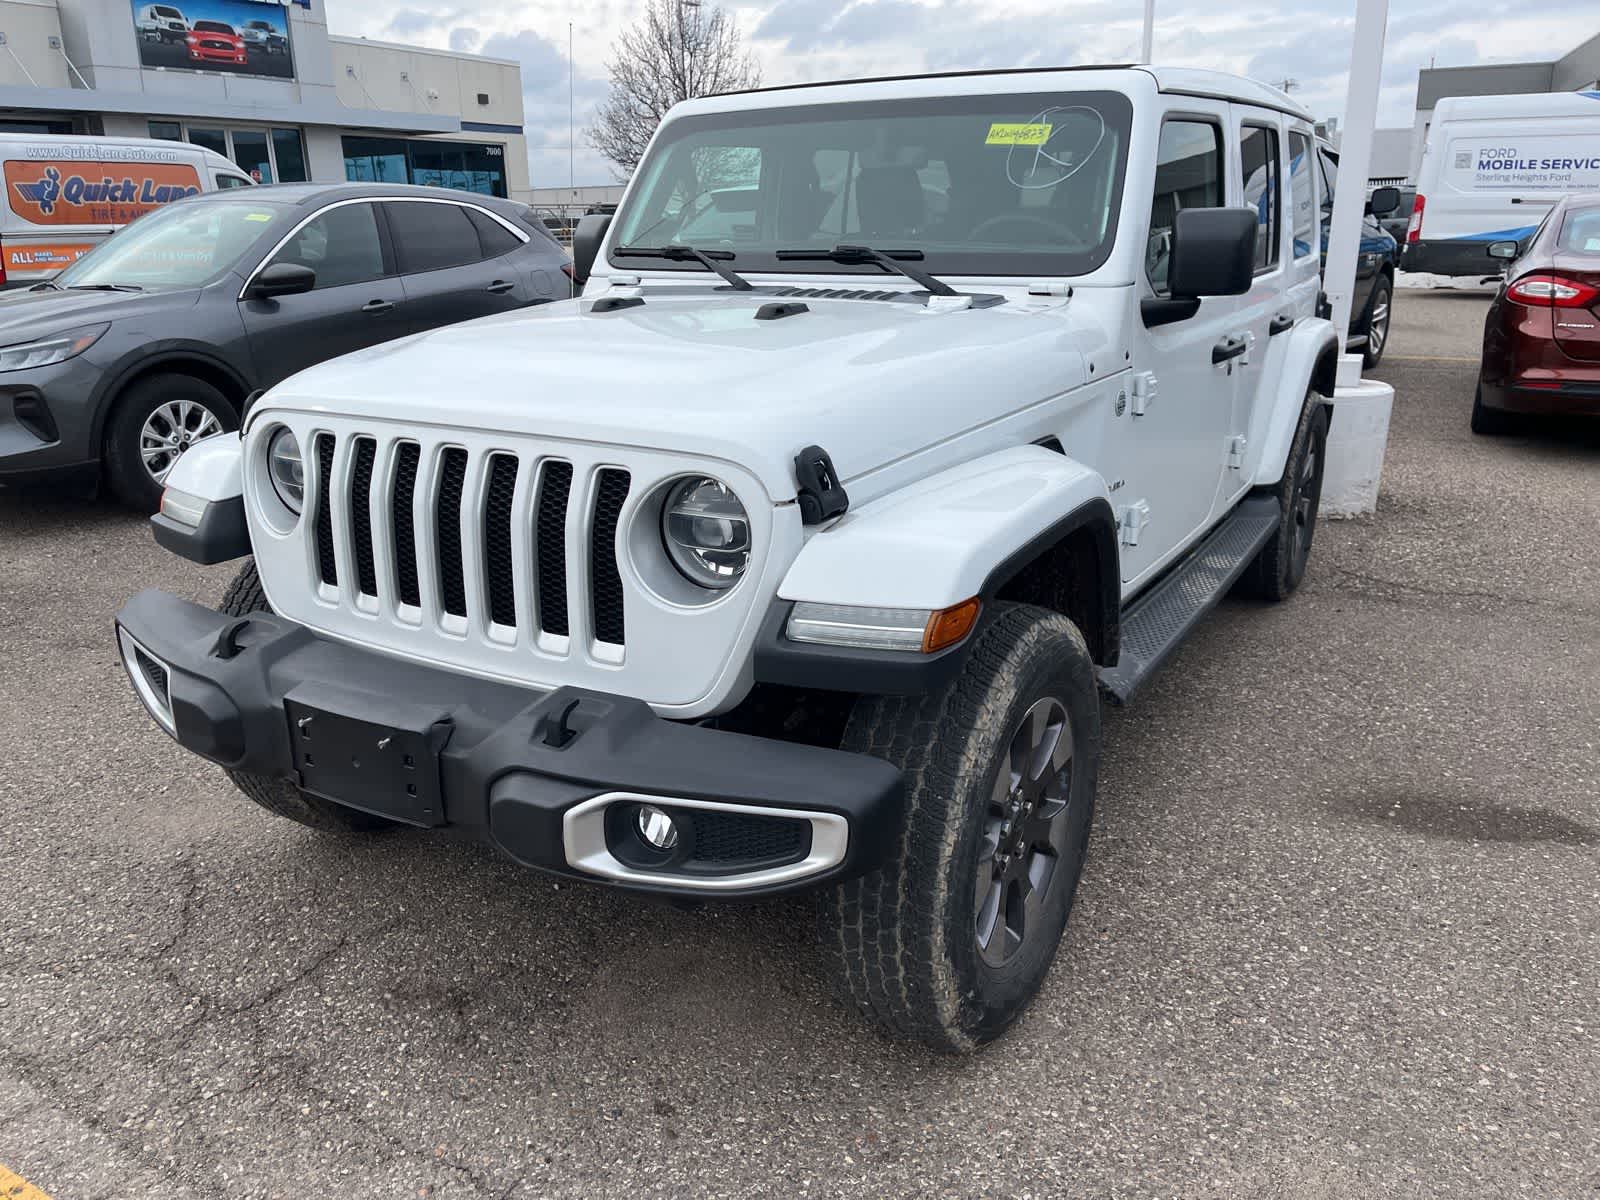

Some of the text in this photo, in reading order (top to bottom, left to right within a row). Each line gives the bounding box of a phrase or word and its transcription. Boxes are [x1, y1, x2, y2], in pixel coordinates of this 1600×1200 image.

[1479, 148, 1517, 159] FORD
[1478, 158, 1600, 170] MOBILE SERVIC
[1475, 173, 1571, 183] Sterling Heights Ford
[63, 176, 138, 206] Quick
[90, 208, 115, 220] TIRE
[11, 252, 34, 264] ALL
